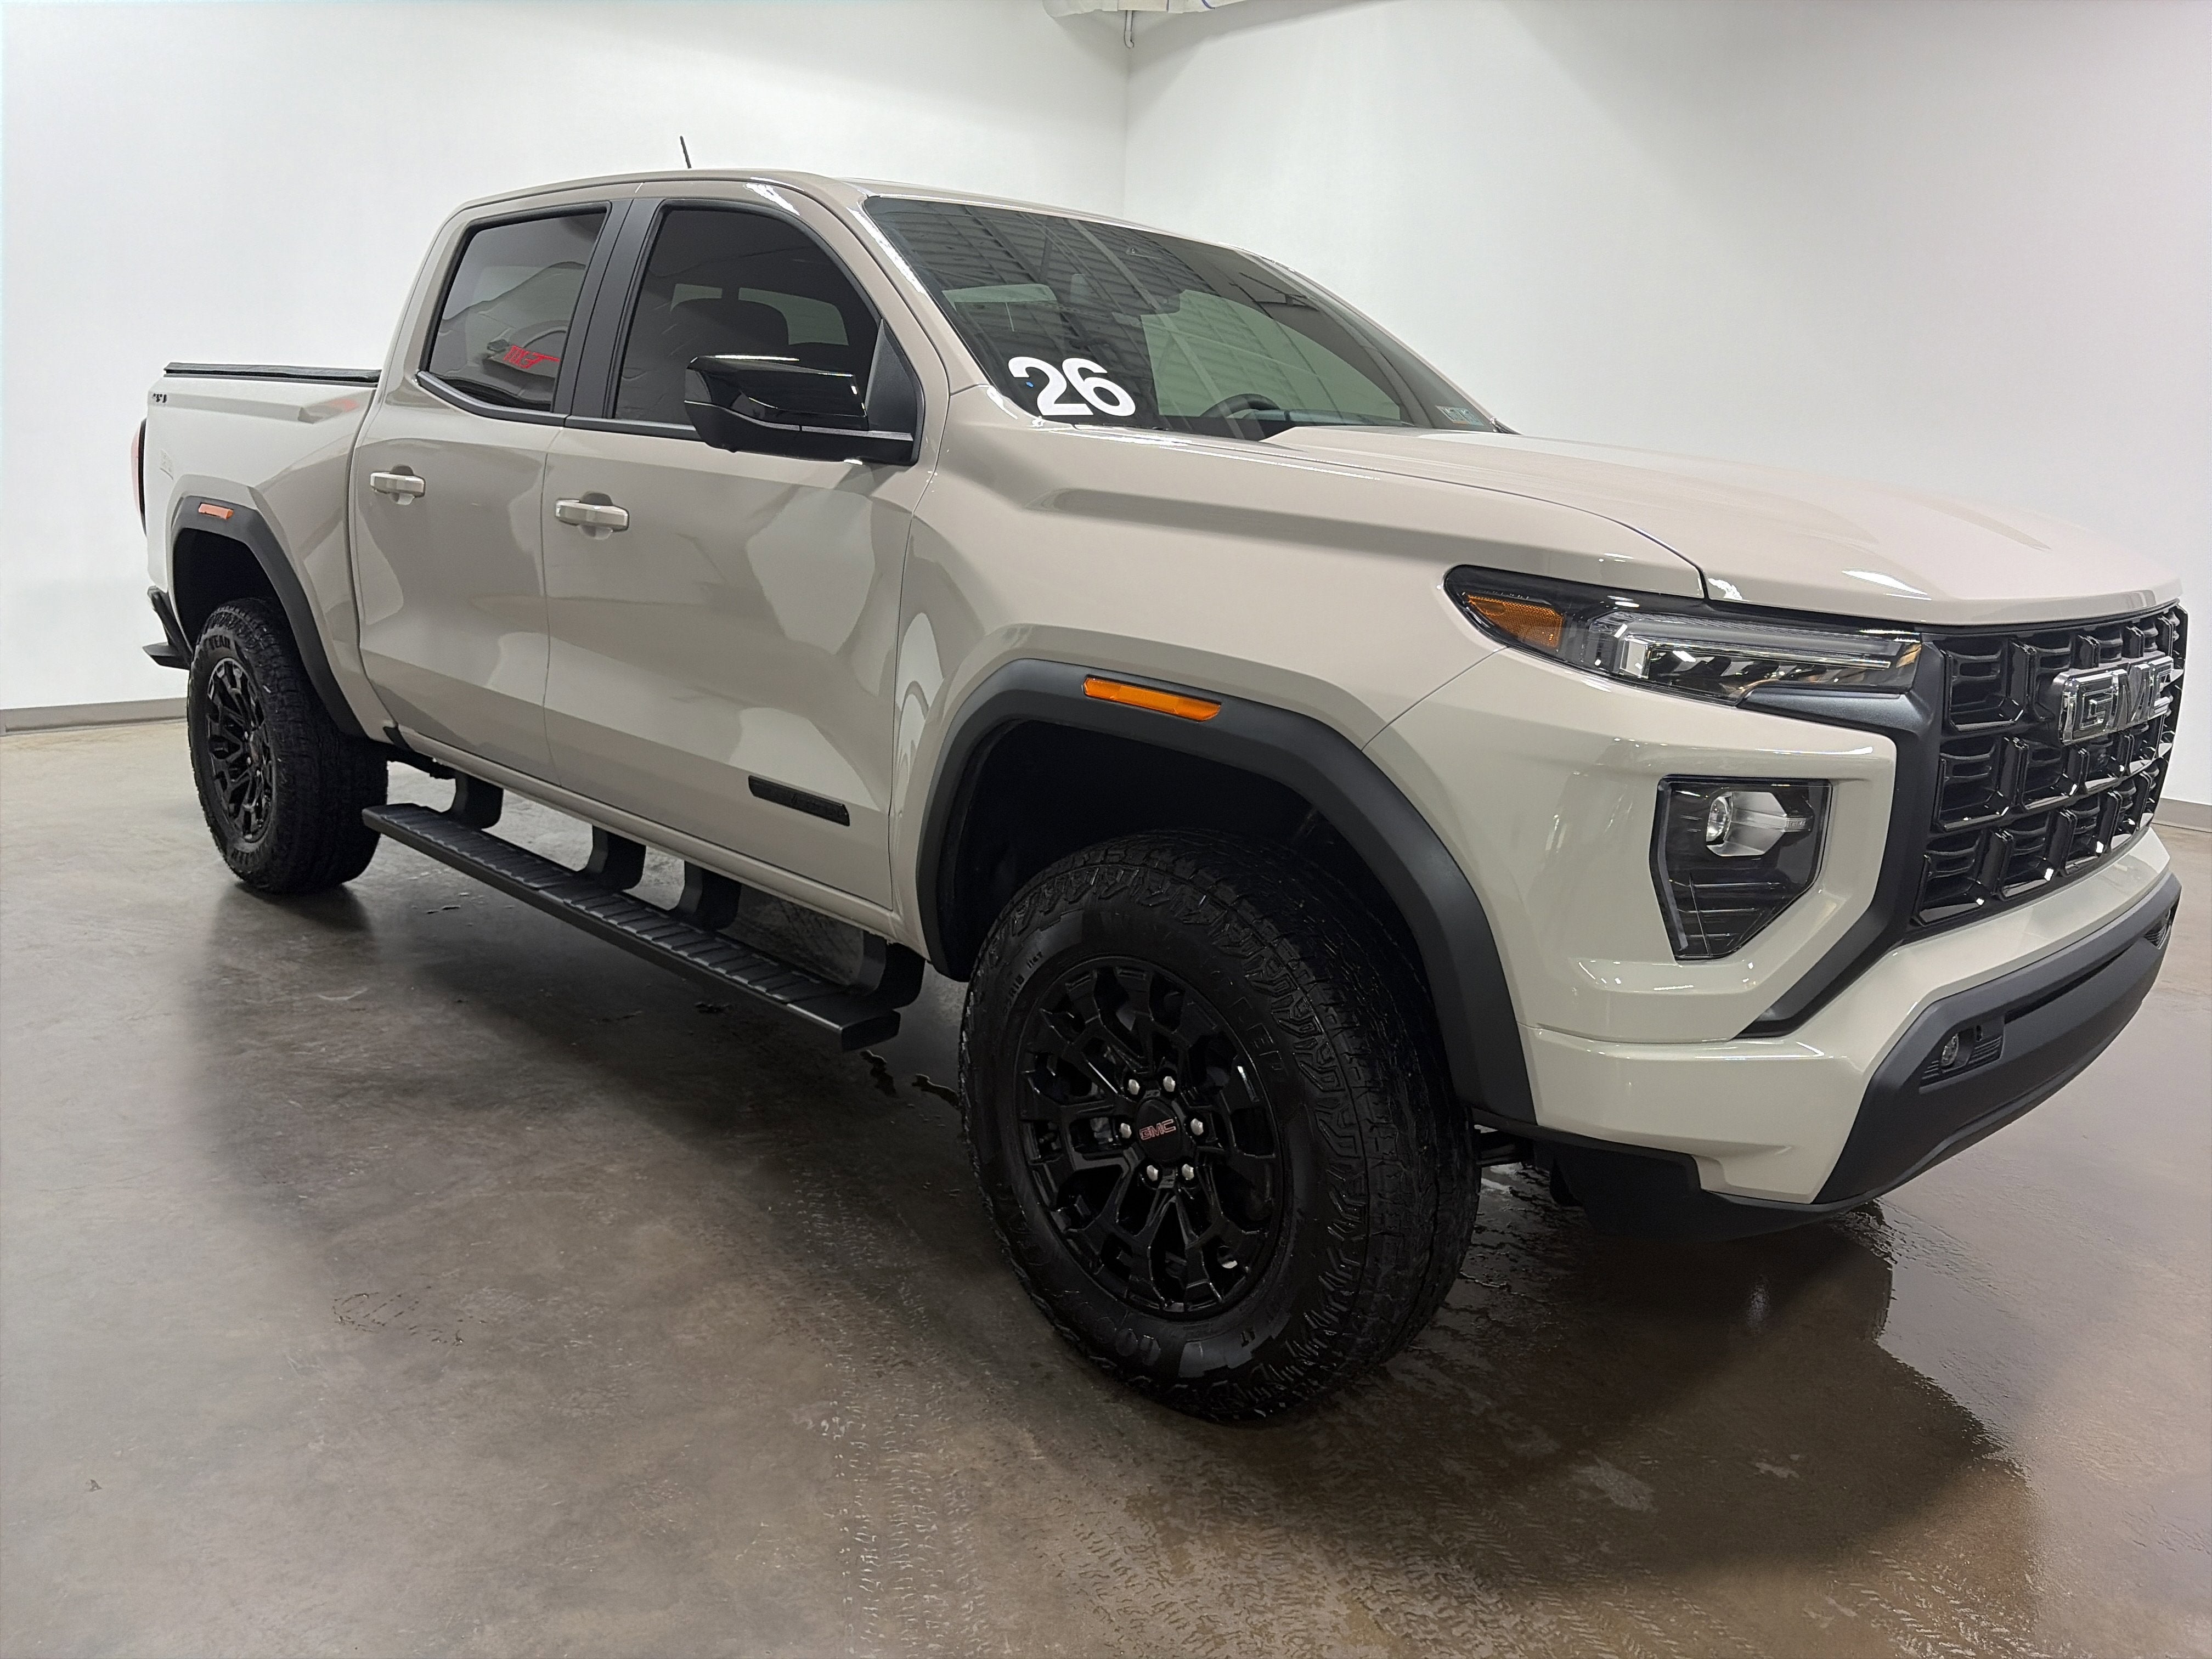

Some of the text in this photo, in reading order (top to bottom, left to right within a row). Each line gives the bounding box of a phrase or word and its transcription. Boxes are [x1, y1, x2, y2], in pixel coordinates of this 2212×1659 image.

[1008, 357, 1136, 416] 26
[2059, 656, 2174, 746] GMC
[1139, 1119, 1176, 1141] GMC
